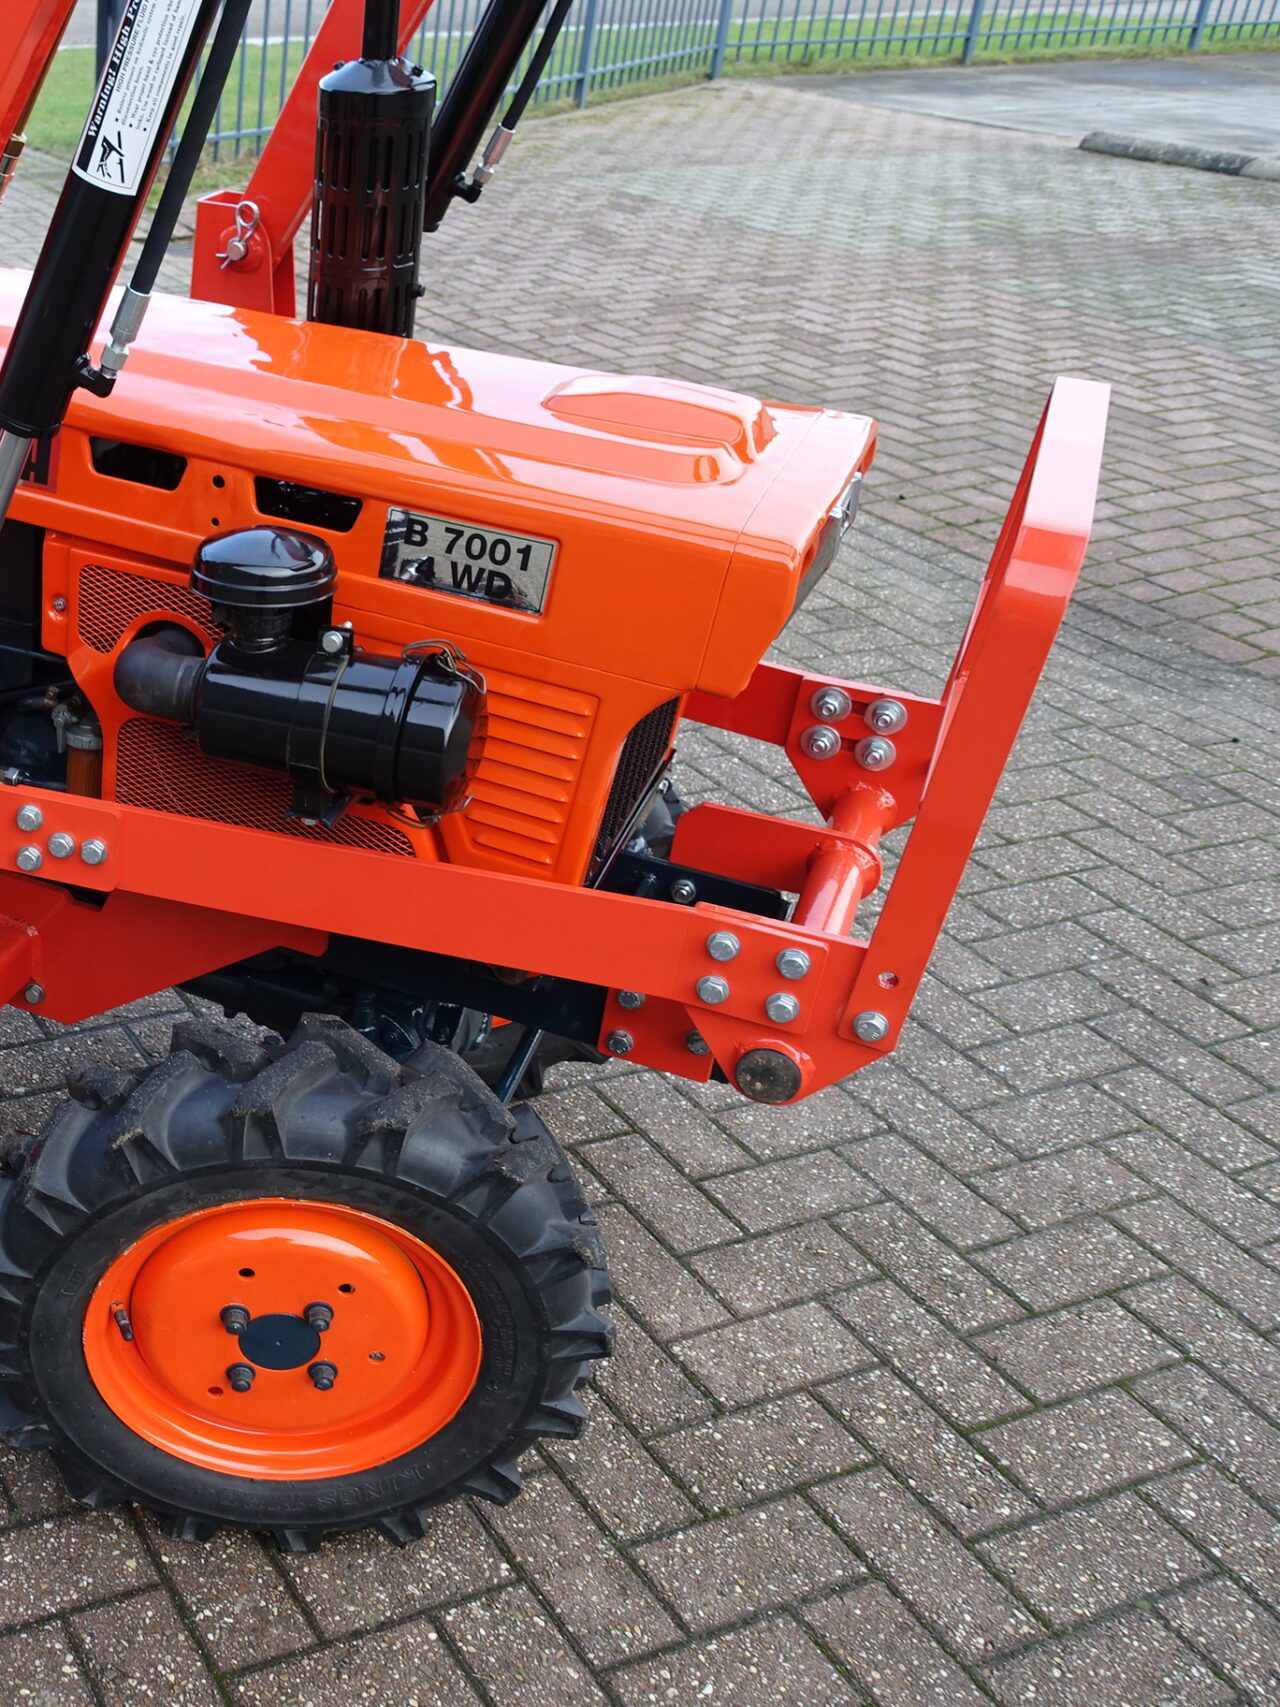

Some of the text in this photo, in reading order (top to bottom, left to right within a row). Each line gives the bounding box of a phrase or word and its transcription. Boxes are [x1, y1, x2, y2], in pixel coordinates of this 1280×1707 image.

[122, 30, 139, 71] PRESSURE
[137, 4, 147, 27] FLUID
[136, 26, 149, 54] hydraulic
[143, 65, 152, 82] hand
[155, 13, 169, 45] protection
[88, 69, 116, 137] Warning!
[112, 26, 130, 65] High
[404, 518, 532, 571] B 7001
[450, 561, 513, 599] WD
